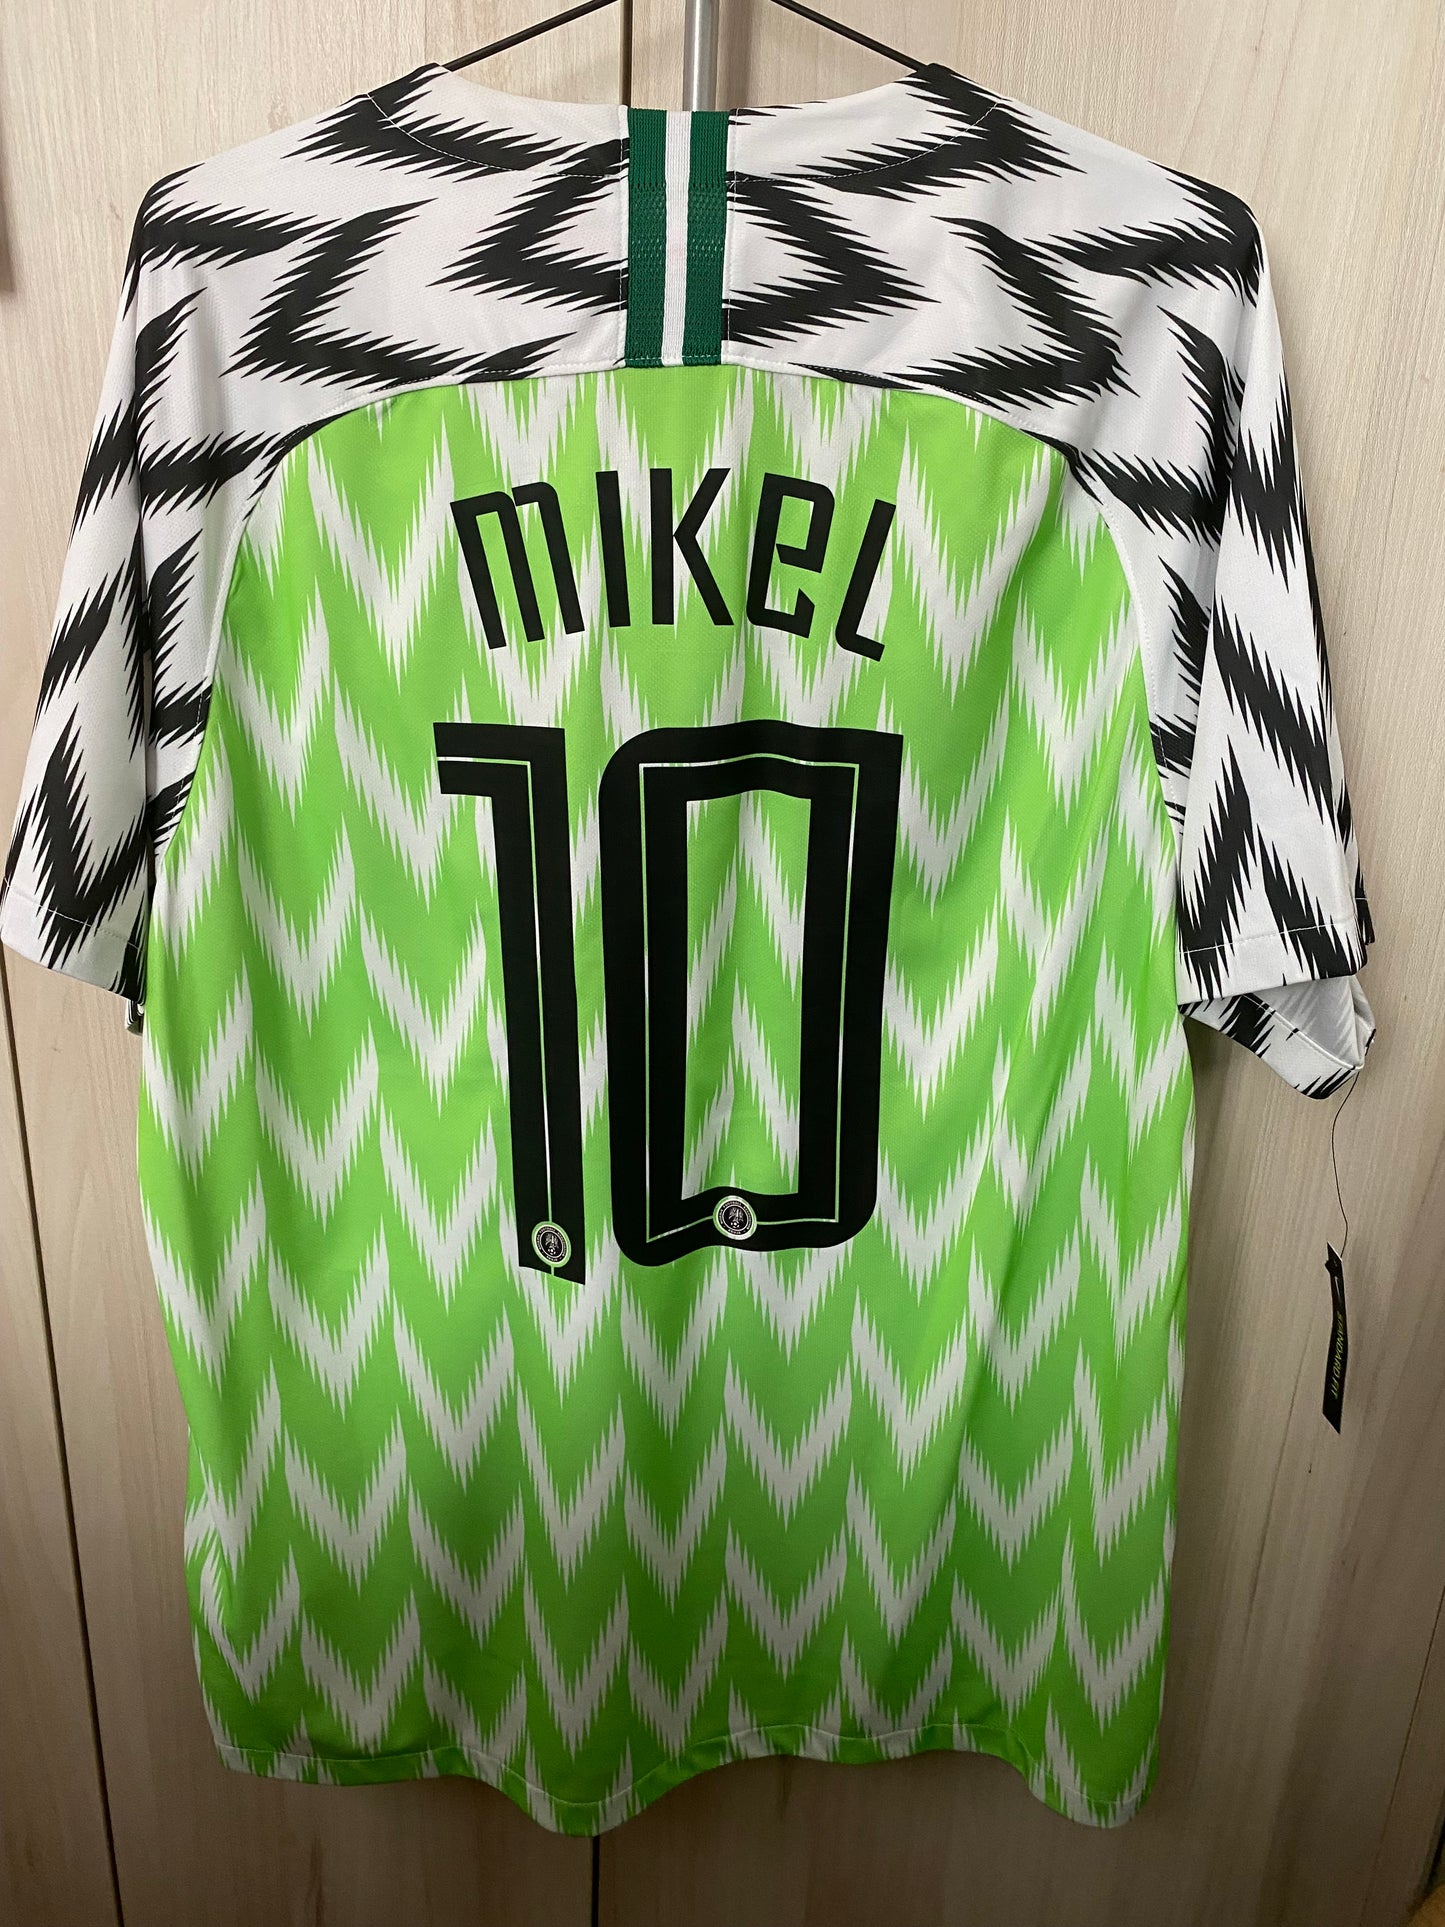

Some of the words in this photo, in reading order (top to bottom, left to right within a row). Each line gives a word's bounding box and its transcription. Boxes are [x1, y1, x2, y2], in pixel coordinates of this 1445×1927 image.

[450, 468, 896, 661] MIKEL
[433, 720, 903, 1285] 10
[1331, 1377, 1340, 1400] FIT
[1332, 1310, 1344, 1378] STANDARD
